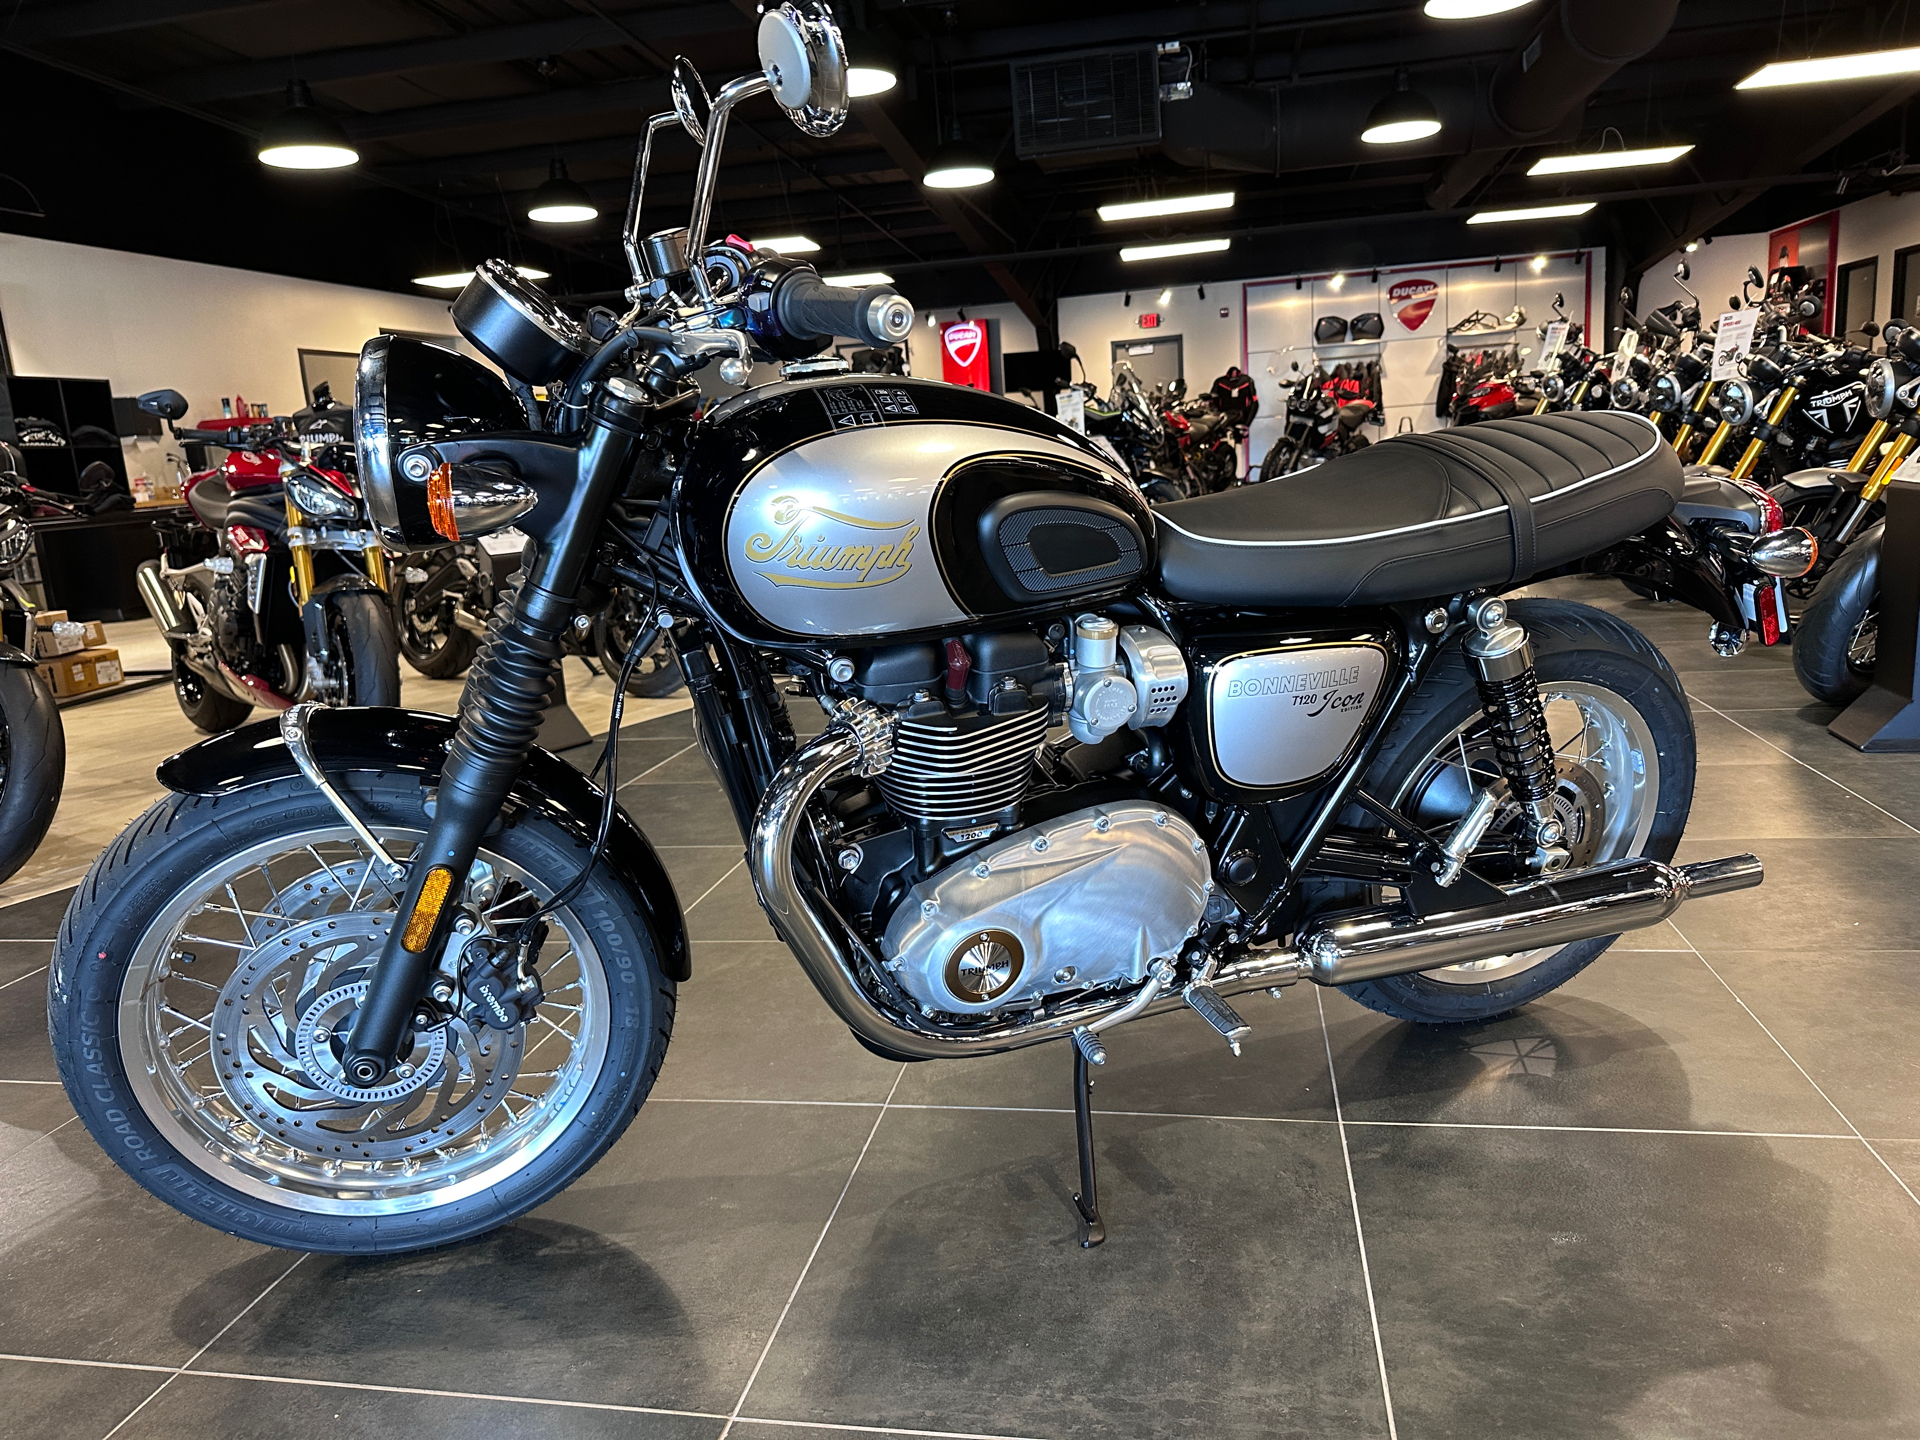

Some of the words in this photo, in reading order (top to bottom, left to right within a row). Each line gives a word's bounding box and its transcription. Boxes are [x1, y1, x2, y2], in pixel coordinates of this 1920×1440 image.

[1392, 284, 1434, 297] DUCATI
[948, 330, 977, 340] DUCATI
[1810, 389, 1853, 407] TRIUMPH
[744, 495, 921, 591] Triumph
[1227, 665, 1360, 698] BONNEVILLE
[1292, 693, 1318, 706] T120
[1307, 689, 1365, 718] Icon
[1340, 705, 1363, 713] EDITION
[591, 909, 636, 984] 100/90
[960, 960, 1009, 977] TRIUMPH
[479, 984, 509, 1023] brembo
[80, 1009, 117, 1103] CLASSIC
[105, 1107, 158, 1162] ROAD
[155, 1165, 300, 1236] MICHELIN
